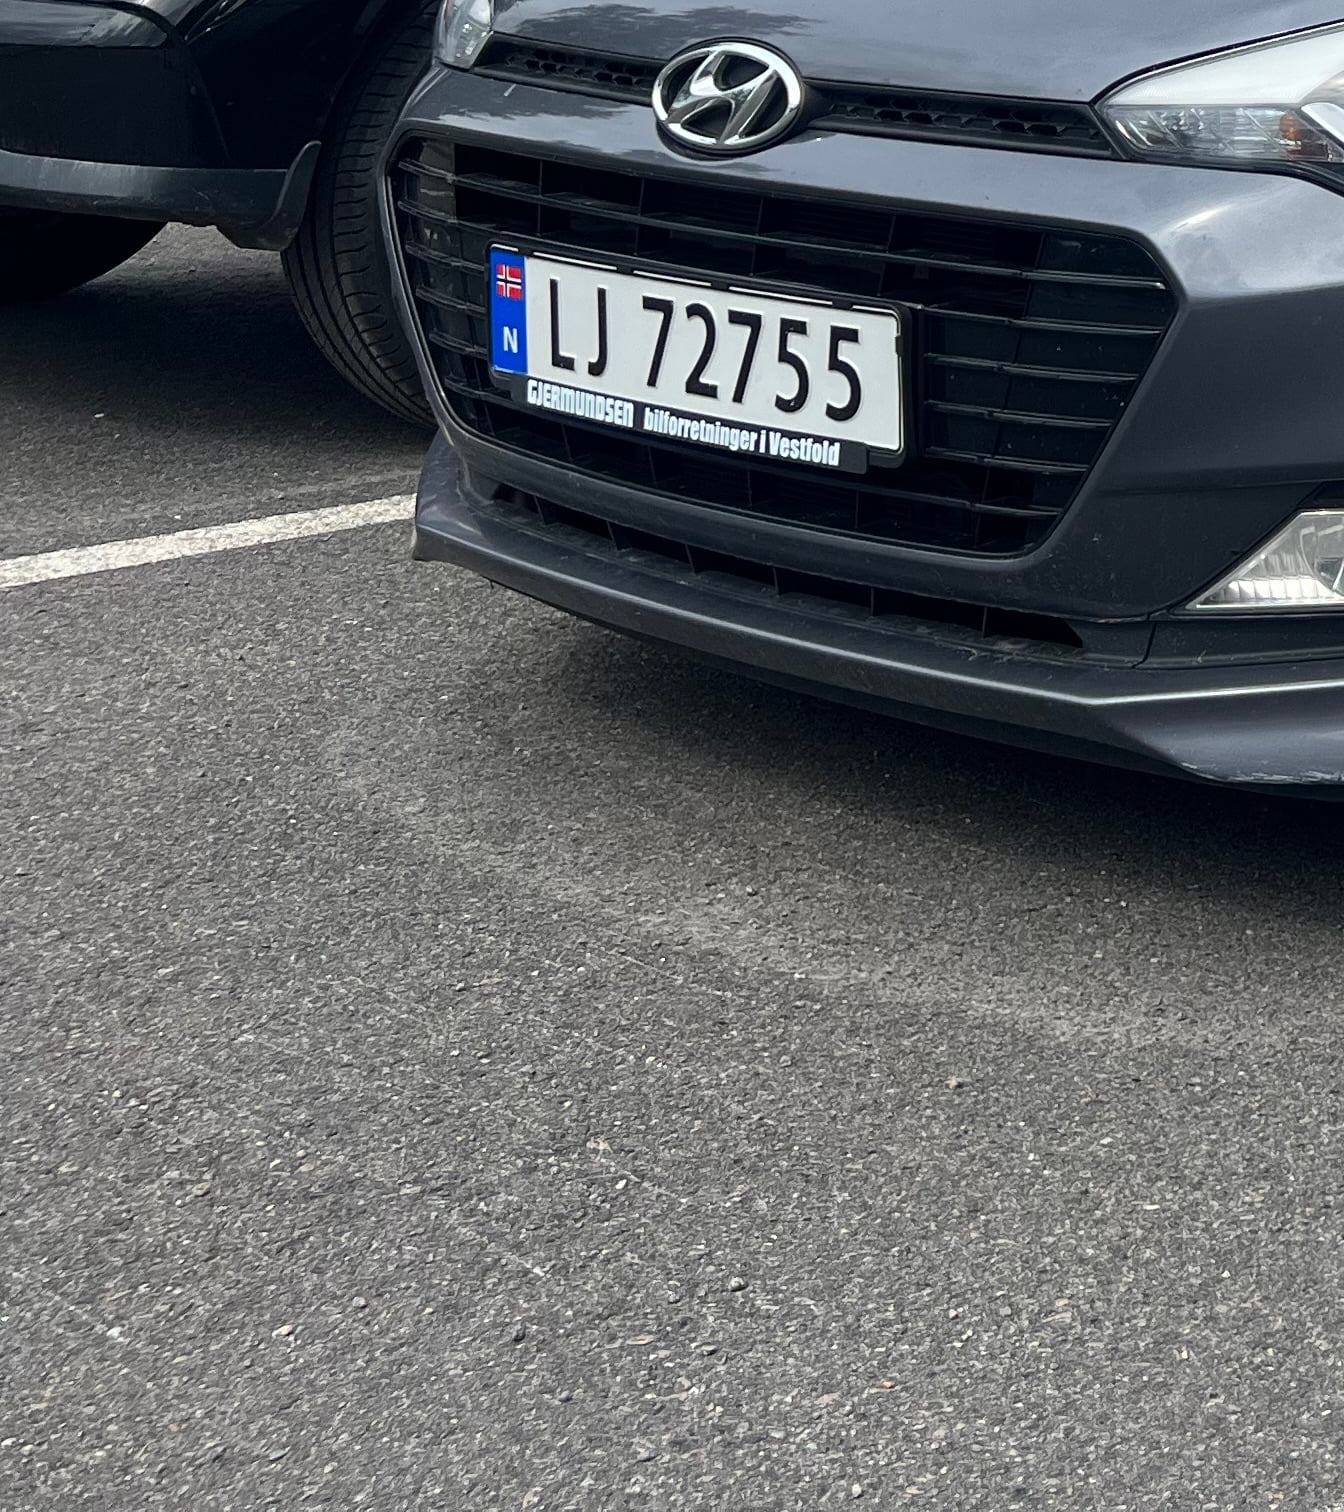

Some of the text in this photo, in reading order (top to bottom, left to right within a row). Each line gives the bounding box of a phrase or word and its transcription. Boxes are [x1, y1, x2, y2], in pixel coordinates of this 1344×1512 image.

[502, 325, 519, 354] N
[549, 277, 862, 422] LJ 72755
[526, 379, 842, 466] GJERMUNDSEN bilforretninger i Vestfold
